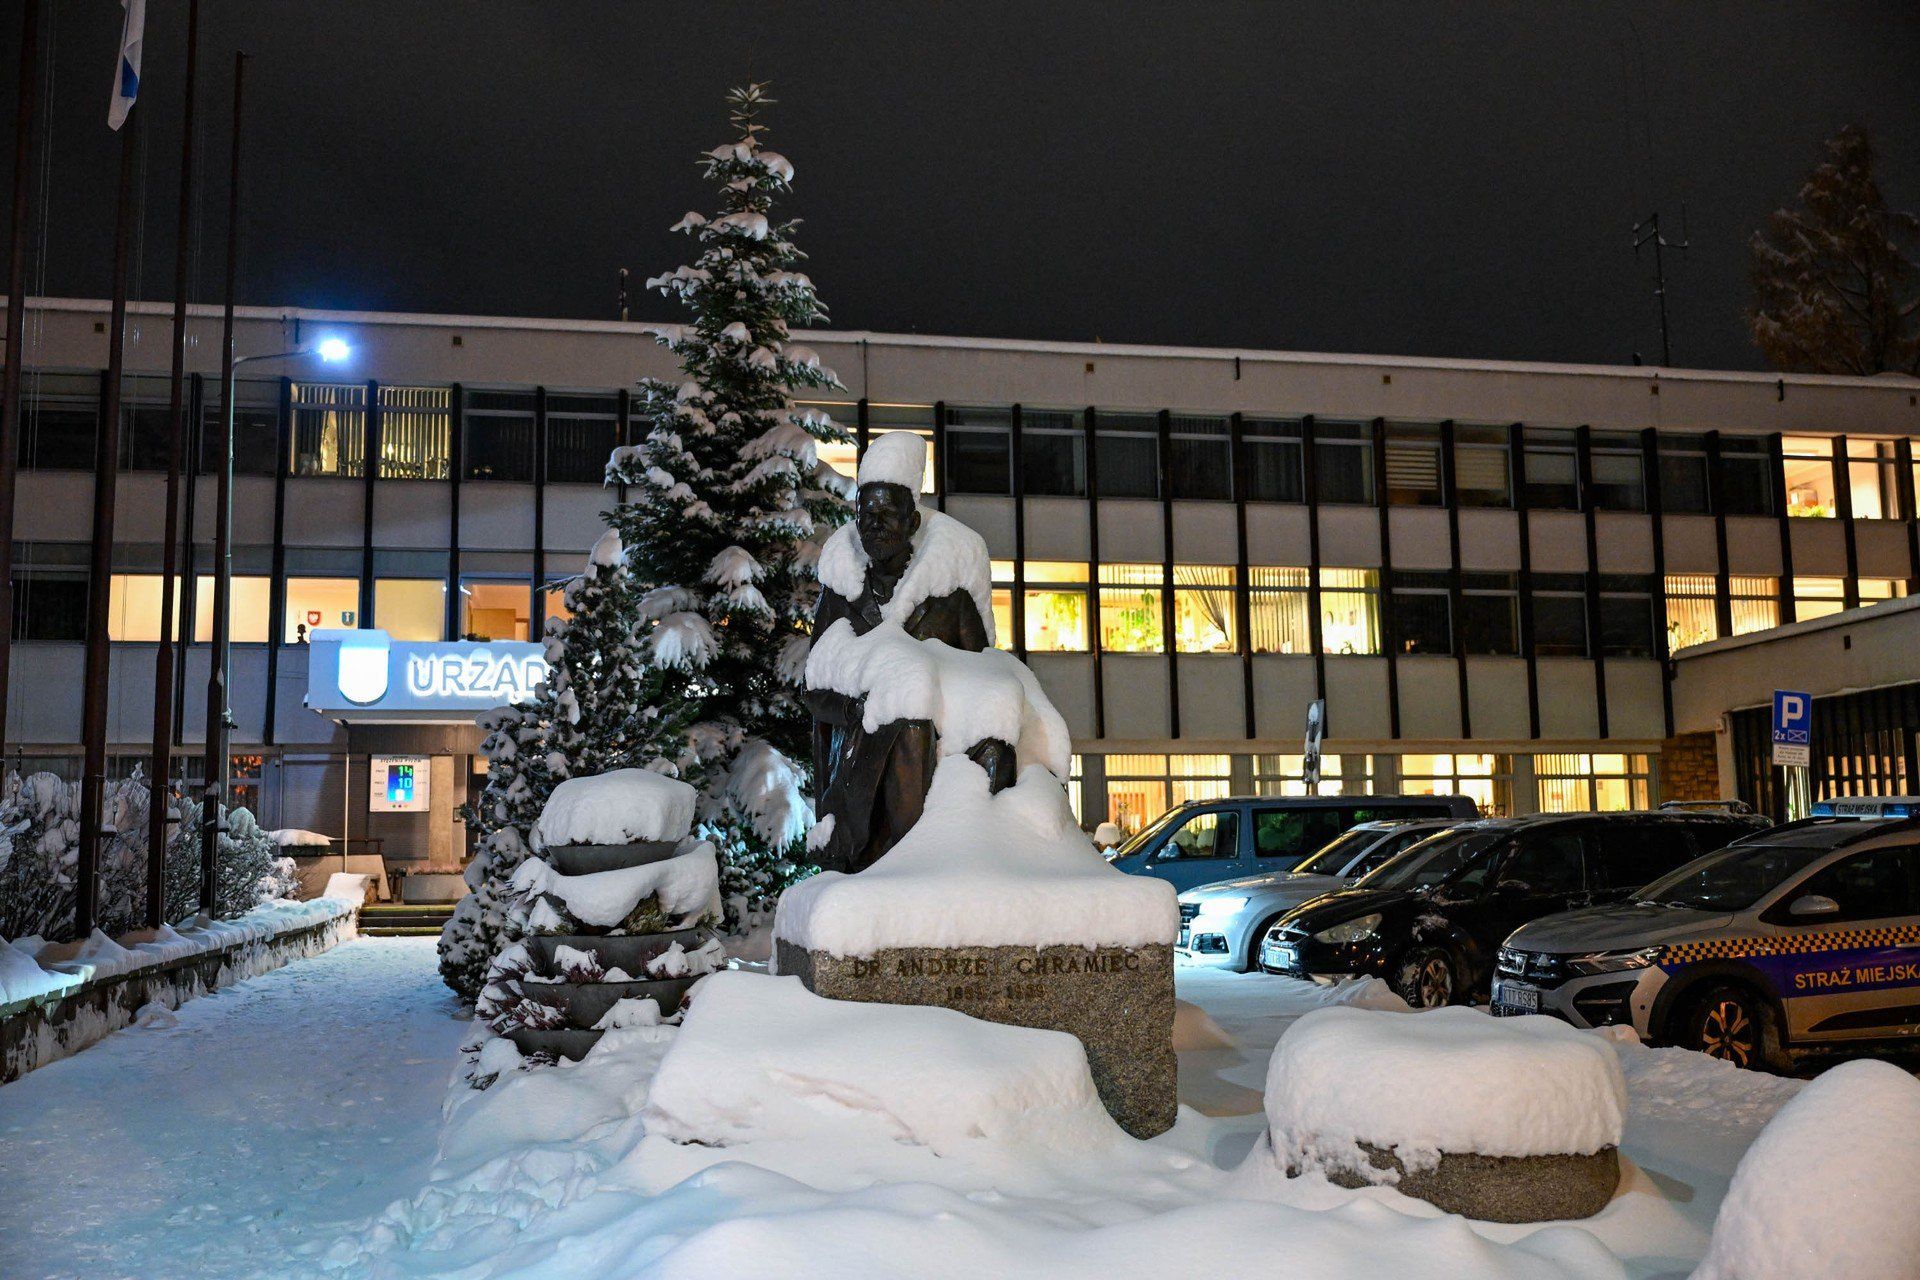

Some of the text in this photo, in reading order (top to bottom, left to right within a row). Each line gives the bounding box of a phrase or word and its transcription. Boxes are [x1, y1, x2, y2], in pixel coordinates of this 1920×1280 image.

[1782, 695, 1803, 728] P
[1774, 729, 1786, 740] 2x
[398, 765, 413, 777] 14
[398, 777, 413, 789] 10
[853, 959, 882, 979] DR
[1016, 953, 1140, 974] CHRAMIEC
[1794, 963, 1920, 989] STRAŻ MIEJSK
